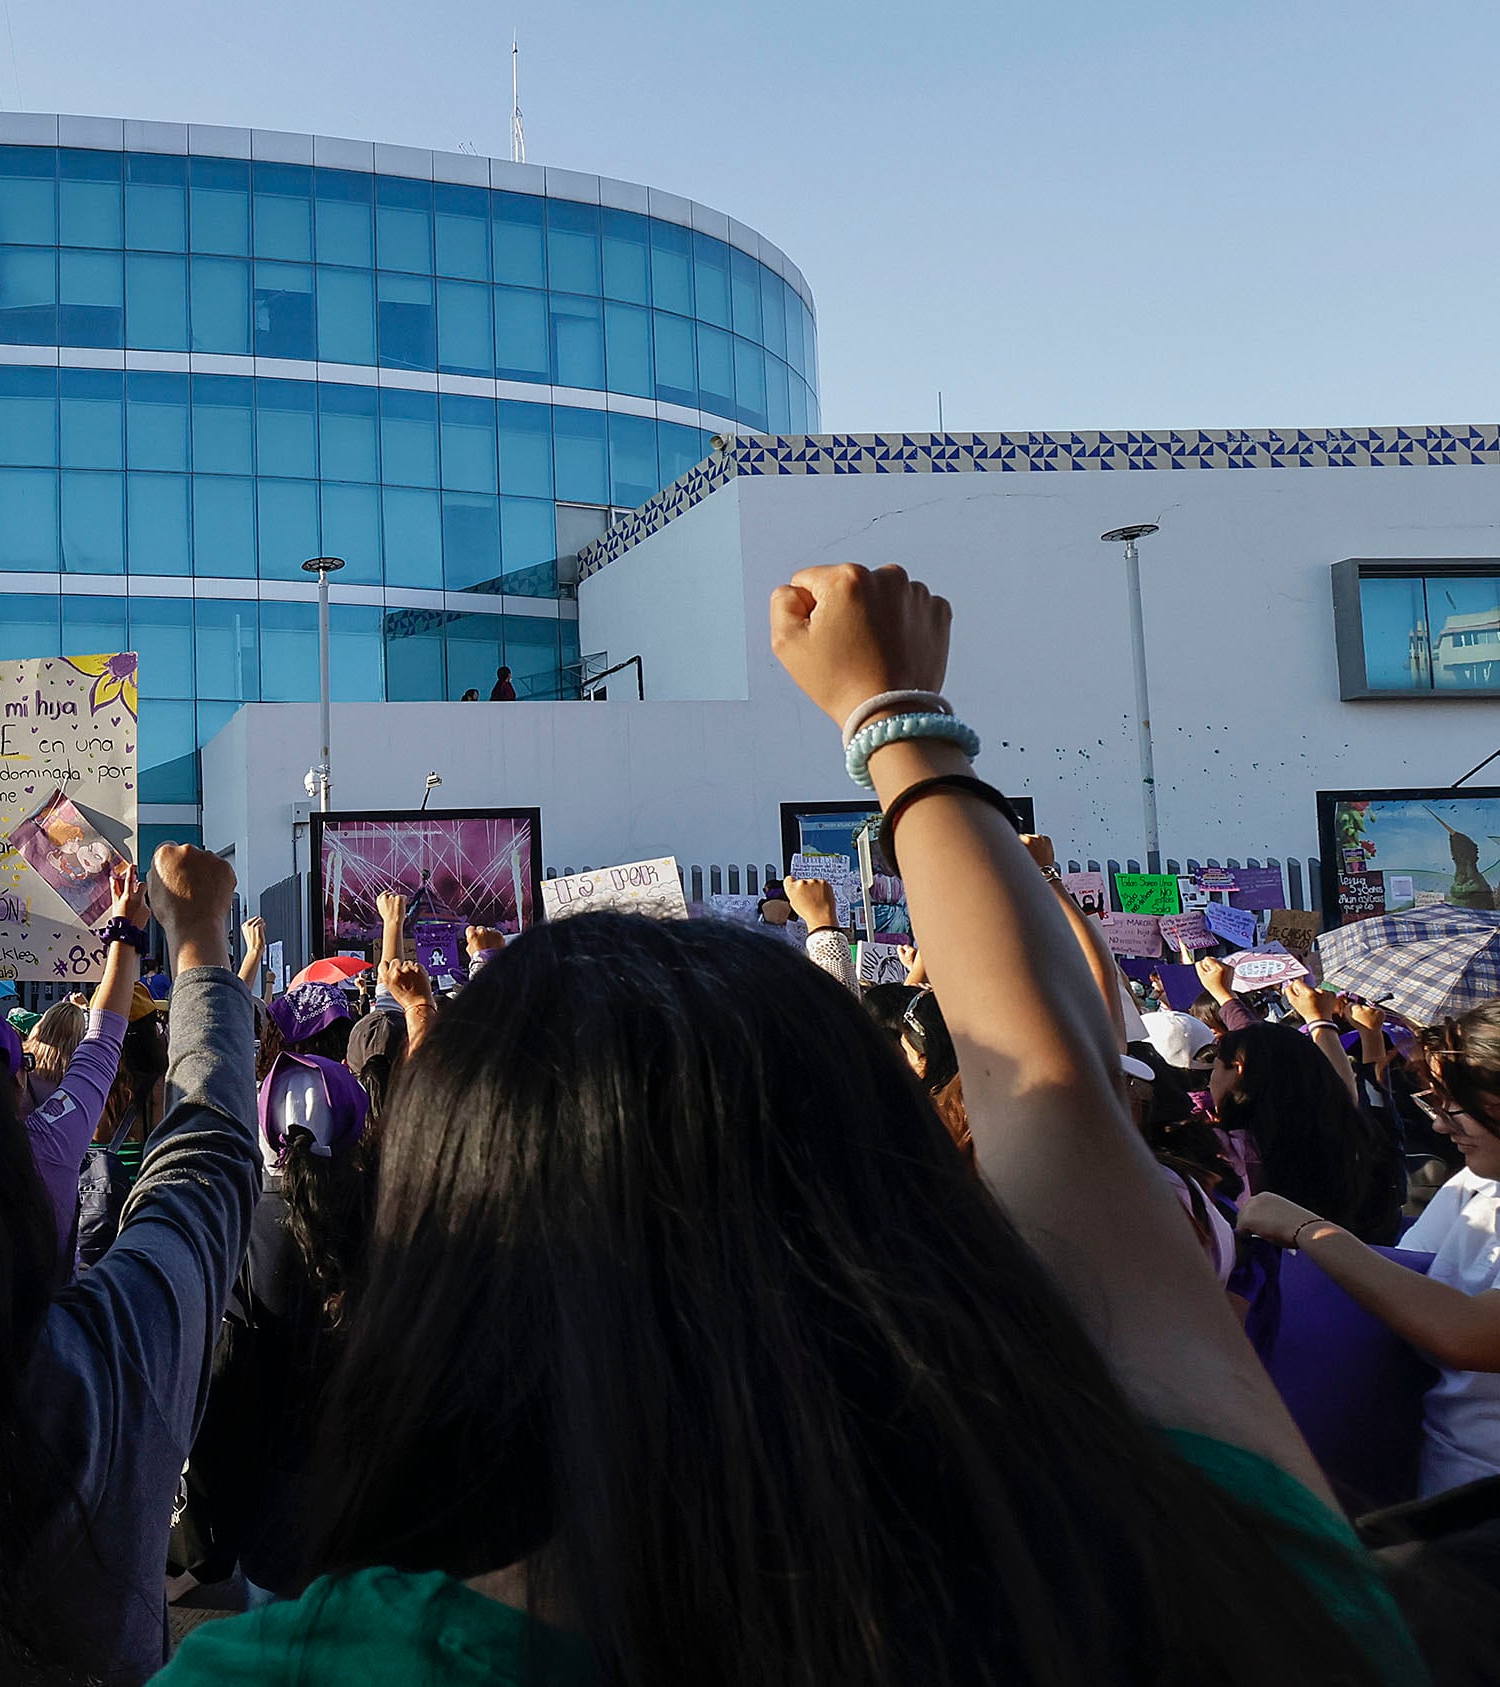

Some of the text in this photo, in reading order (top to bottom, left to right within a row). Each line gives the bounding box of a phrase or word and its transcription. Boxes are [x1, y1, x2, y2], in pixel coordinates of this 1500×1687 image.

[5, 695, 29, 718] mi
[35, 690, 78, 720] hija
[39, 739, 65, 753] en
[76, 738, 113, 752] una
[0, 759, 80, 780] dominada
[98, 765, 132, 783] por
